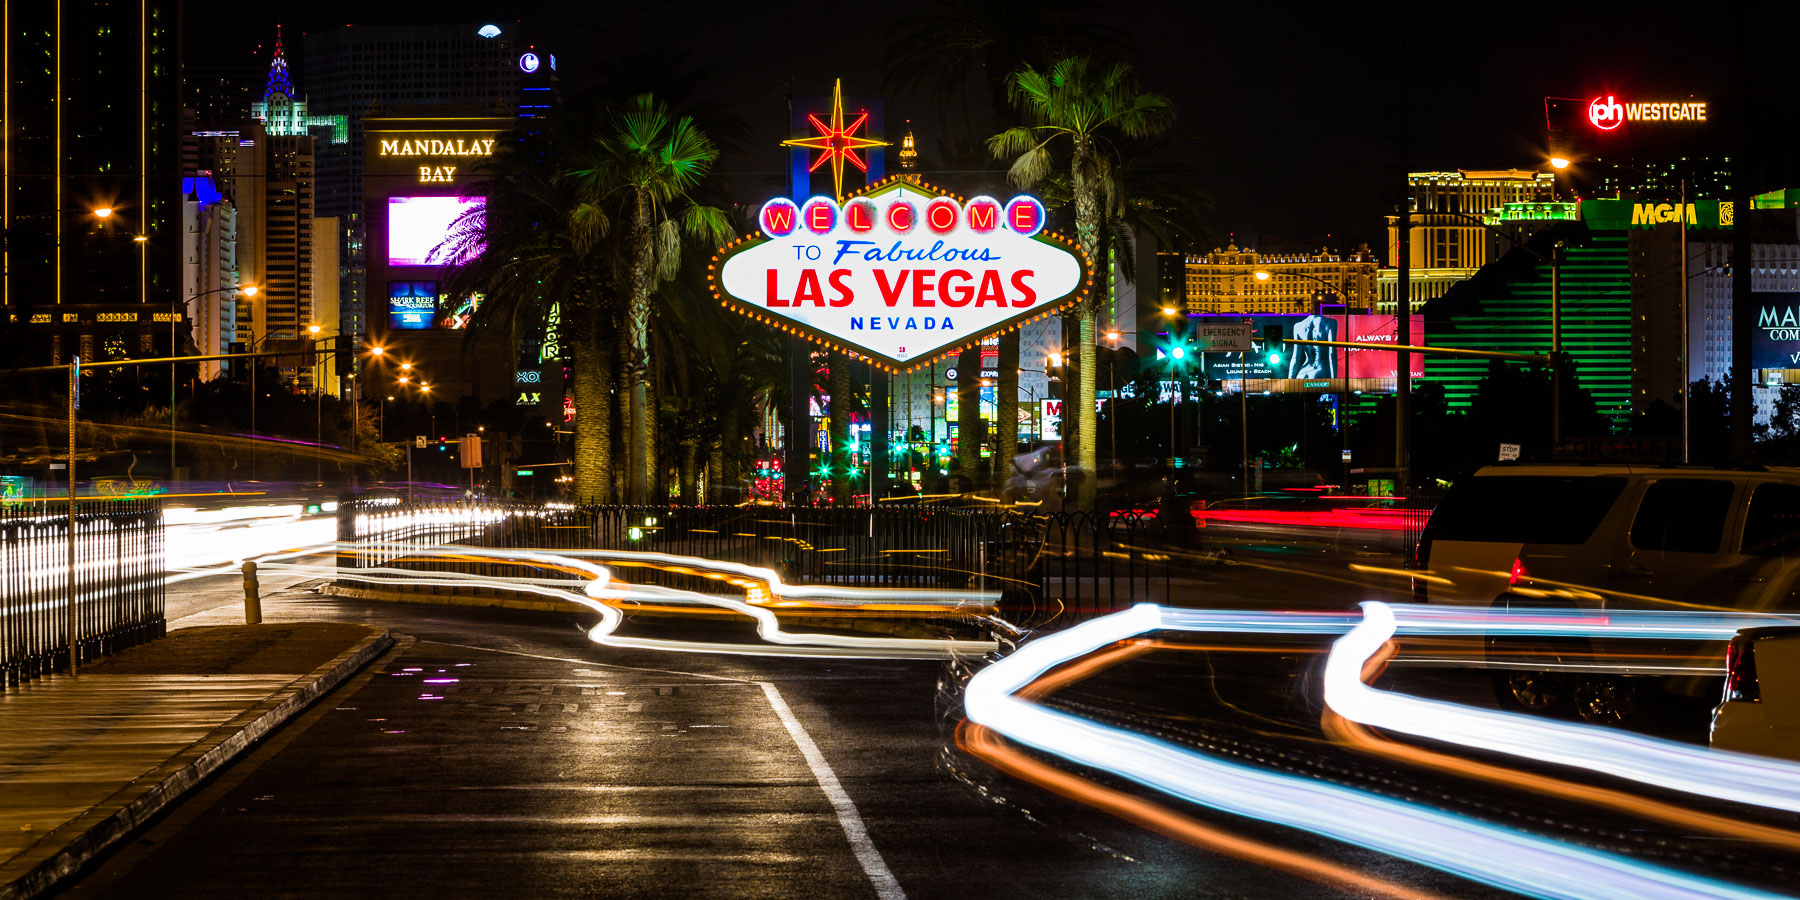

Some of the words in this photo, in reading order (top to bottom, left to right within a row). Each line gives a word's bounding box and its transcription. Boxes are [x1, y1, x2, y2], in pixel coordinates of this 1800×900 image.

[1625, 103, 1707, 121] WESTGATE
[380, 139, 495, 156] MANDALAY
[419, 166, 456, 182] BAY
[767, 204, 1033, 231] WELCOME
[1631, 203, 1698, 225] MGM
[792, 245, 821, 261] TO
[833, 240, 1002, 266] Fabulous
[766, 269, 854, 308] LAS
[872, 269, 1037, 308] VEGAS
[416, 296, 434, 304] REEF
[850, 317, 954, 330] NEVADA
[1758, 305, 1800, 327] MA
[1203, 328, 1246, 337] EMERGENCY
[1356, 334, 1391, 342] ALWAYS
[1212, 340, 1238, 348] SIGNAL
